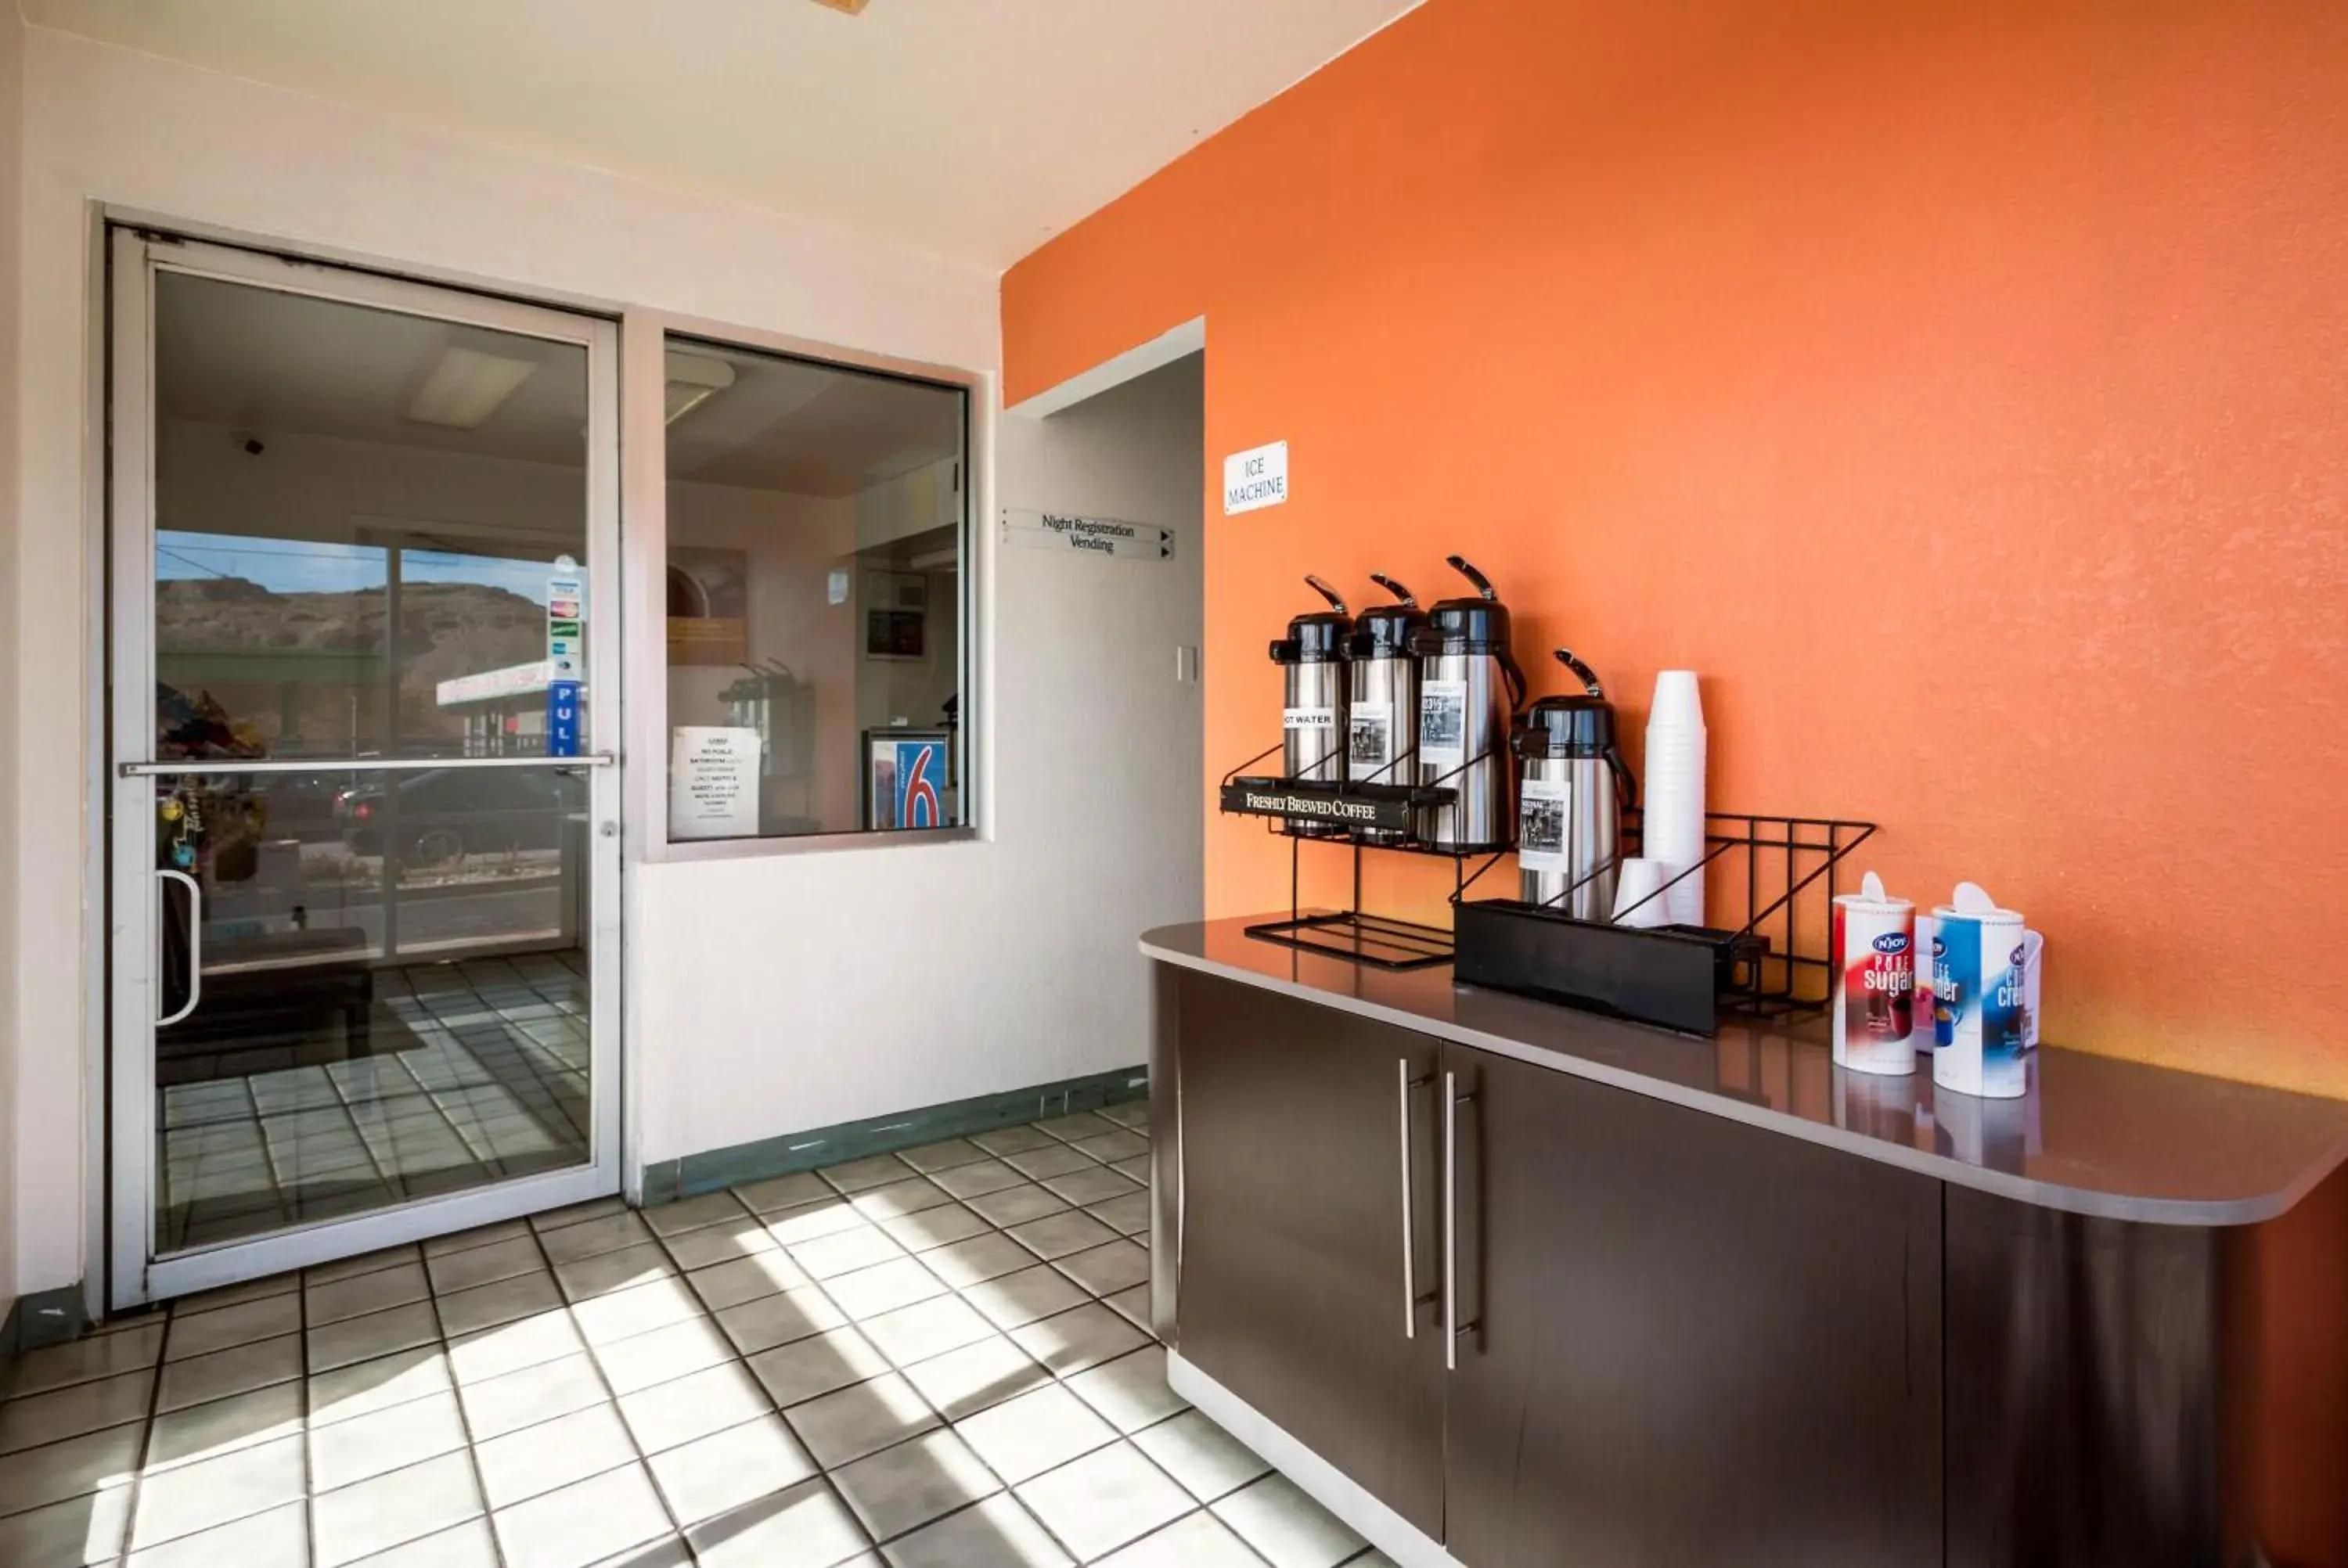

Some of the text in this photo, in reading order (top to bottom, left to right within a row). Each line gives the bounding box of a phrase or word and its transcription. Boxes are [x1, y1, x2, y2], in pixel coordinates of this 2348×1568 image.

[1245, 457, 1264, 477] ICE
[1227, 476, 1284, 505] MACHINE
[1042, 514, 1134, 537] Night Registration
[1070, 534, 1115, 555] Vending
[1284, 715, 1331, 724] OT WATER
[1246, 793, 1376, 820] FRESHLY BREWED COFFEE
[1874, 955, 1910, 971] PURE
